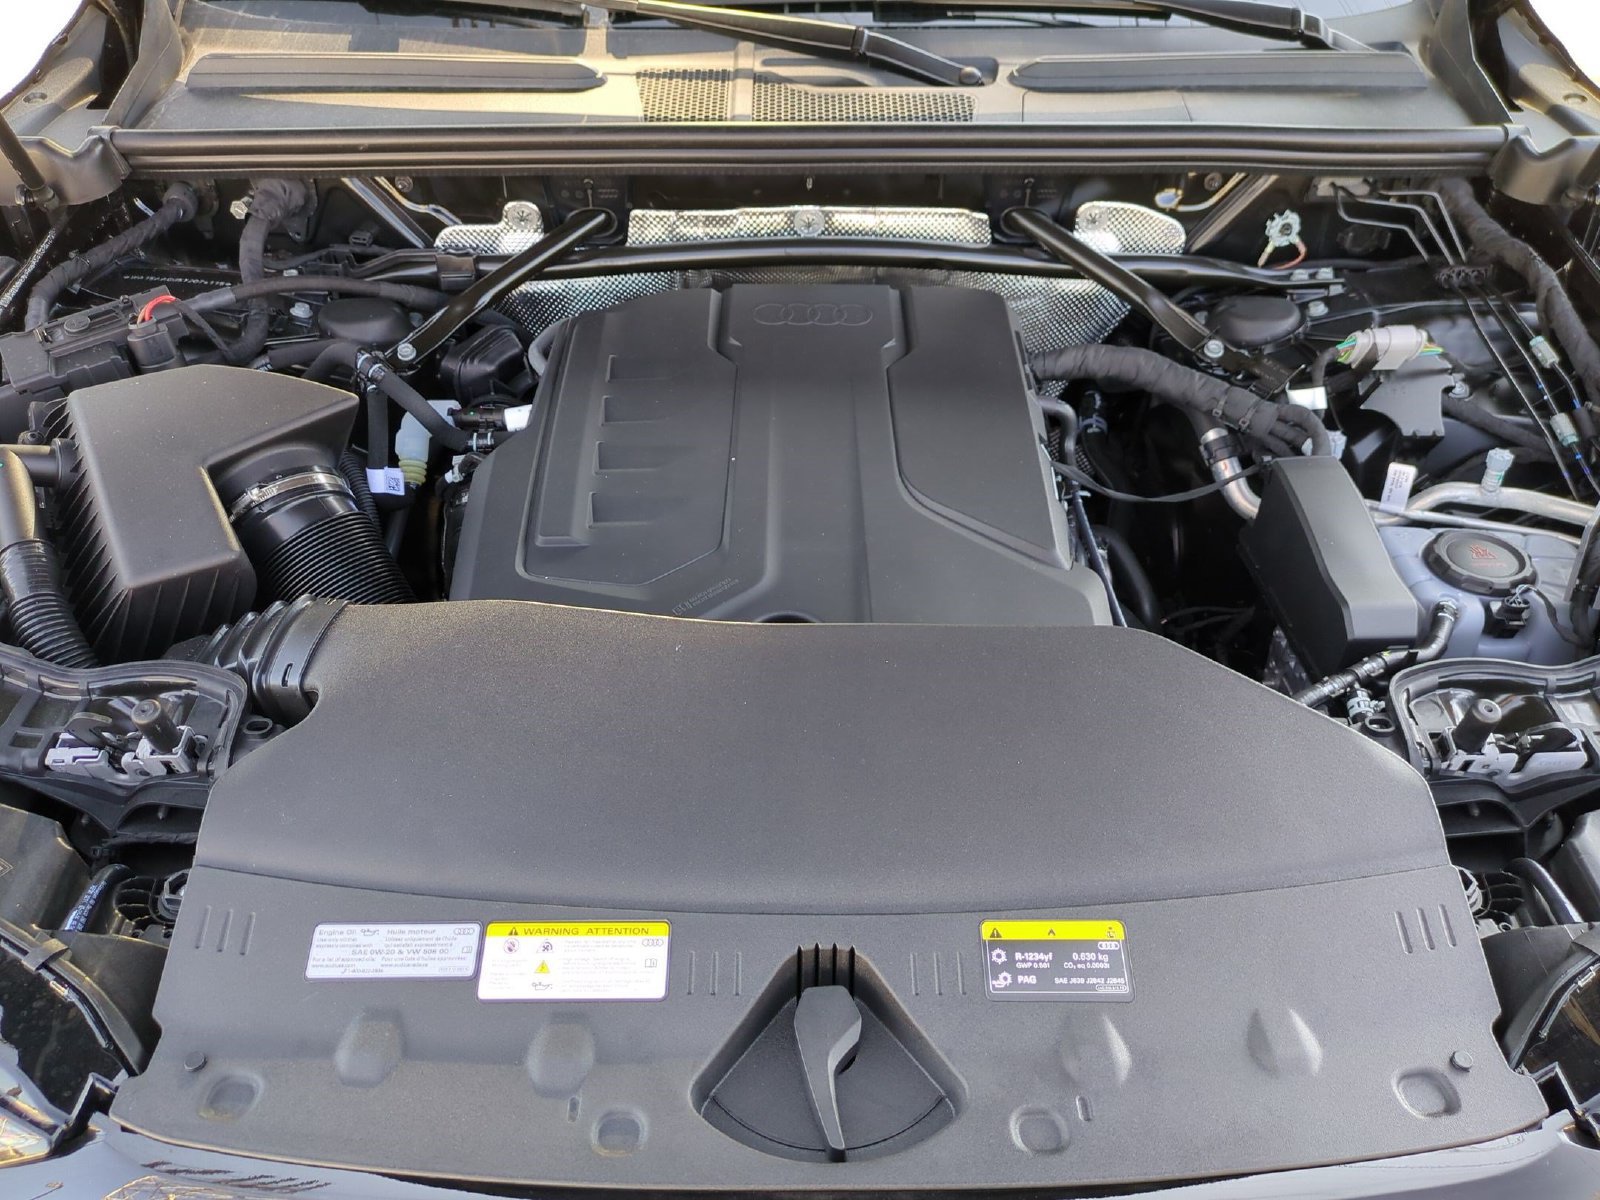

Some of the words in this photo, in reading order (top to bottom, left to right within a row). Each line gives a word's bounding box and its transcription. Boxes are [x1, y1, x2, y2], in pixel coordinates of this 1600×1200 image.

[1015, 952, 1053, 962] R-1234yf
[1072, 952, 1096, 961] 0.630
[1097, 952, 1109, 962] kg
[1017, 975, 1037, 984] PAG
